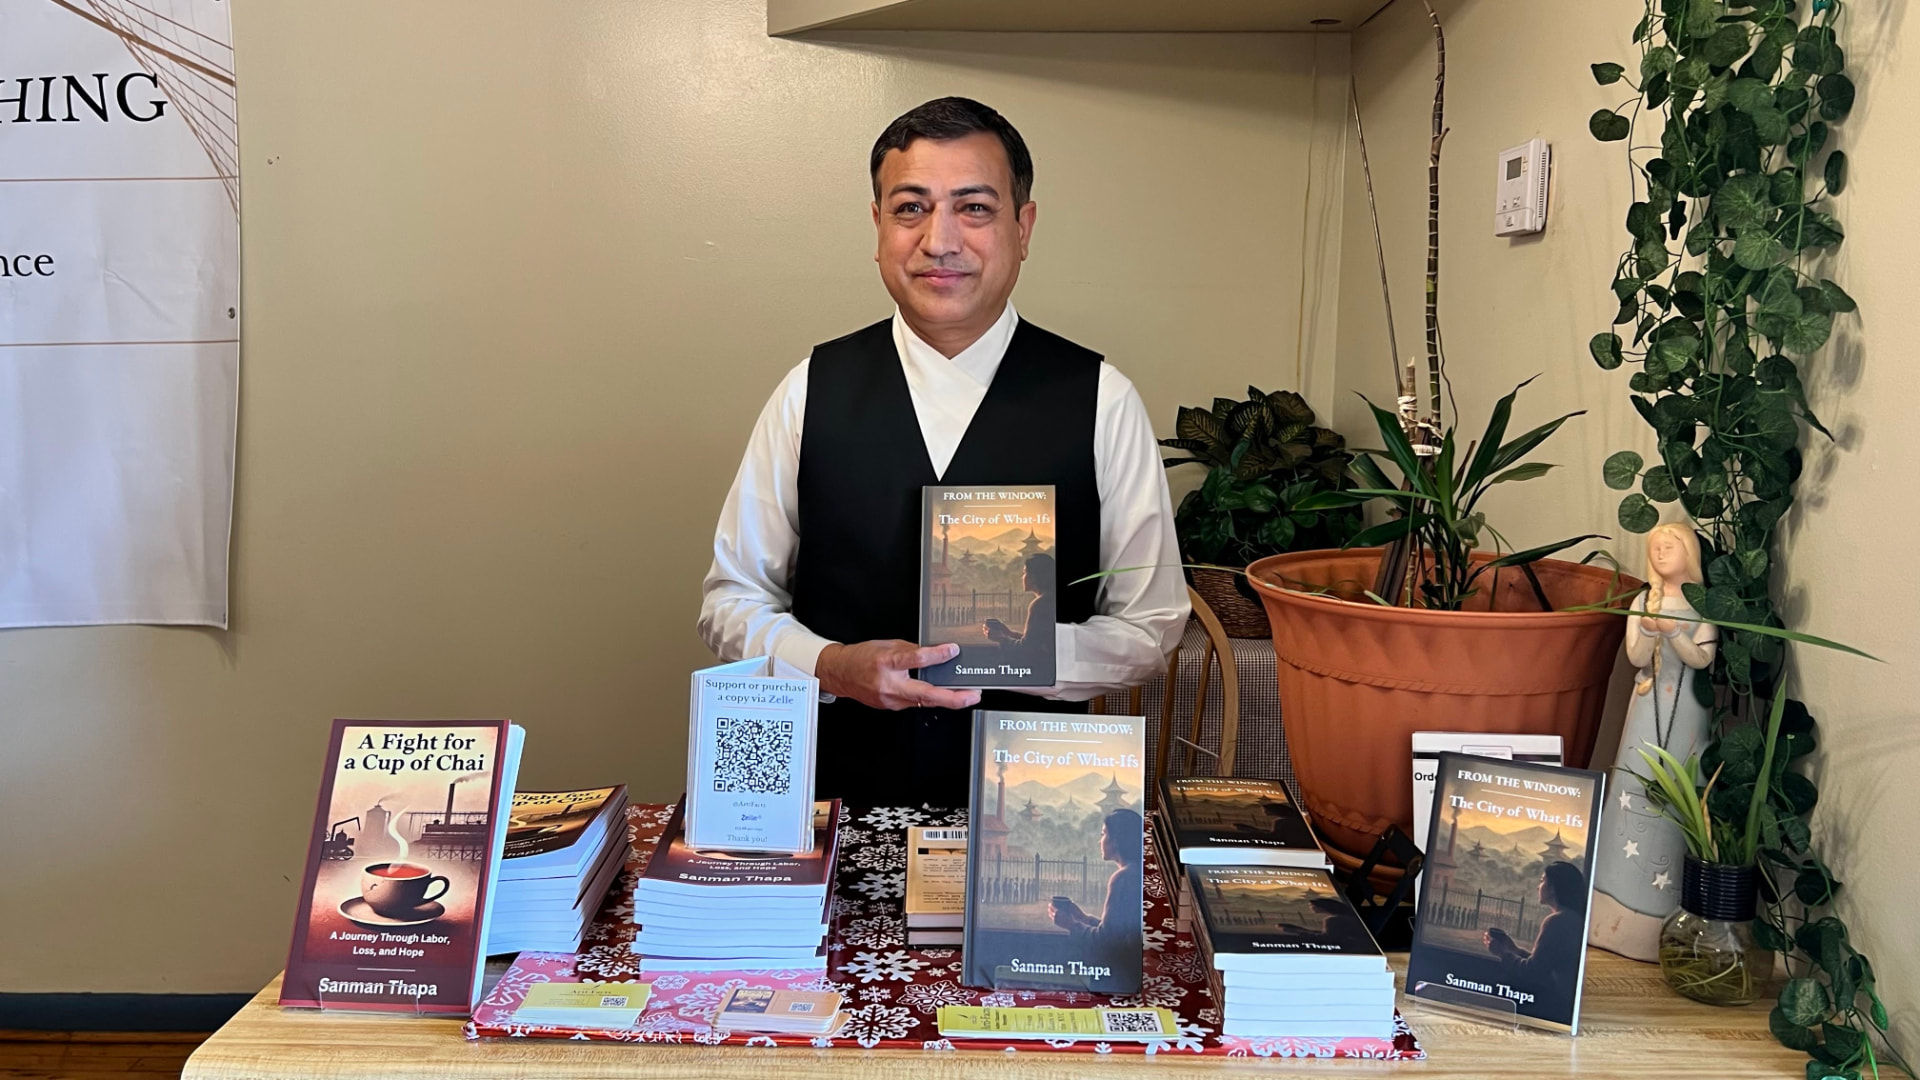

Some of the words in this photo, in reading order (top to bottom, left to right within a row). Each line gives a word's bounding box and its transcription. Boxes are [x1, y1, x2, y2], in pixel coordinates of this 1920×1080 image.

[0, 73, 168, 122] HING
[943, 492, 972, 500] FROM
[975, 492, 996, 500] THE
[998, 491, 1046, 500] WINDOW:
[939, 514, 959, 524] The
[962, 514, 986, 528] City
[988, 514, 1000, 524] of
[1003, 514, 1050, 524] What-Ifs
[955, 665, 996, 674] Sanman
[998, 665, 1032, 678] Thapa
[705, 679, 746, 690] Support
[762, 682, 807, 692] purchase
[725, 695, 748, 704] copy
[751, 694, 766, 702] via
[768, 695, 794, 704] Zelle
[999, 719, 1037, 732] FROM
[1041, 721, 1068, 732] THE
[1070, 722, 1133, 734] WINDOW:
[358, 733, 374, 750] A
[381, 733, 438, 754] Fight
[443, 733, 476, 750] for
[344, 758, 356, 770] a
[363, 754, 404, 775] Cup
[410, 754, 434, 770] of
[437, 754, 484, 770] Chai
[992, 749, 1020, 763] The
[1023, 751, 1054, 768] City
[1057, 752, 1073, 766] of
[1077, 753, 1139, 768] What-Ifs
[1414, 772, 1437, 781] Ord
[1457, 770, 1492, 784] FROM
[1495, 775, 1520, 788] THE
[1522, 779, 1581, 798] WINDOW:
[1449, 795, 1473, 810] The
[1476, 800, 1505, 817] City
[1507, 806, 1523, 816] of
[1525, 807, 1582, 828] What-Ifs
[727, 834, 750, 842] Thank
[751, 836, 768, 844] you!
[1252, 838, 1286, 846] Thapa
[679, 873, 740, 882] Sanman
[1266, 870, 1318, 878] WINDOW:
[1232, 878, 1257, 886] City
[1259, 878, 1274, 886] of
[1275, 879, 1328, 888] What-Ifs
[330, 931, 338, 940] A
[339, 932, 378, 943] Journey
[381, 933, 418, 944] Through
[421, 934, 450, 944] Labor,
[353, 946, 376, 956] Loss,
[379, 947, 396, 956] and
[399, 948, 424, 958] Hope
[1252, 941, 1300, 949] Sanman
[1301, 942, 1341, 951] Thapa
[1011, 958, 1064, 974] Sanman
[1068, 961, 1110, 980] Thapa
[319, 978, 384, 994] Sanman
[388, 980, 438, 998] Thapa
[1445, 973, 1492, 993] Sanman
[1496, 983, 1534, 1004] Thapa
